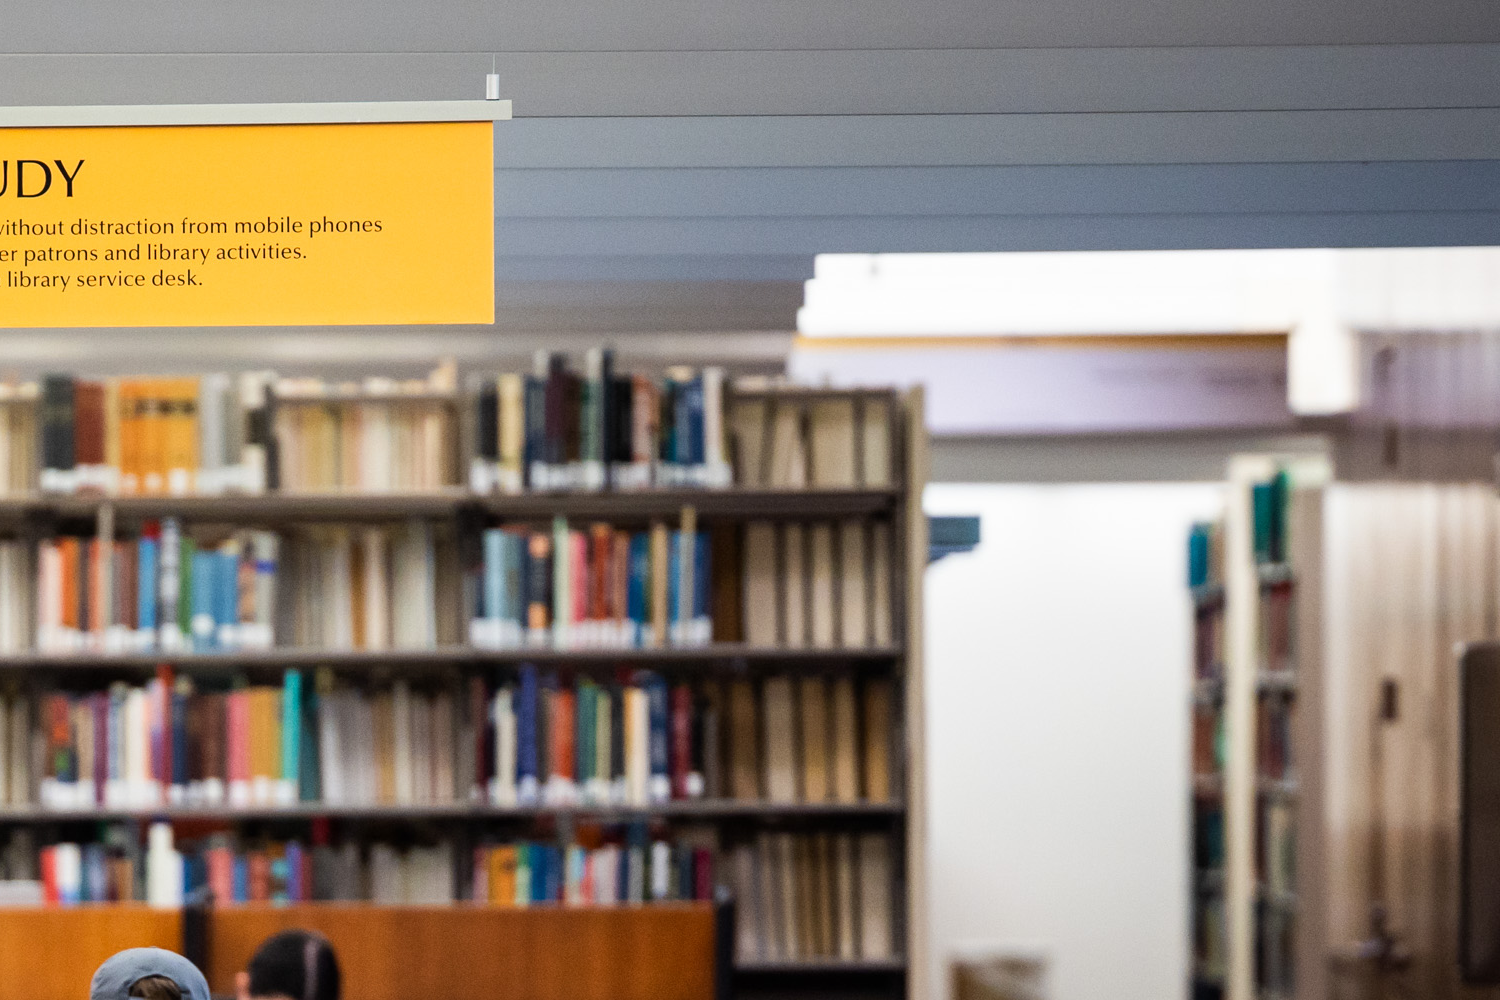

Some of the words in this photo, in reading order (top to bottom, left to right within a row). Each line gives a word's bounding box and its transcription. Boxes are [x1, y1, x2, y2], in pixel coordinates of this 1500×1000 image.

[71, 219, 173, 235] distraction
[181, 217, 227, 235] from
[235, 216, 303, 234] mobile
[310, 216, 382, 238] phones
[25, 248, 97, 266] patrons
[105, 244, 139, 260] and
[148, 244, 209, 264] library
[217, 243, 307, 260] activities.
[9, 271, 70, 292] library
[77, 271, 145, 287] service
[152, 269, 202, 286] desk.
